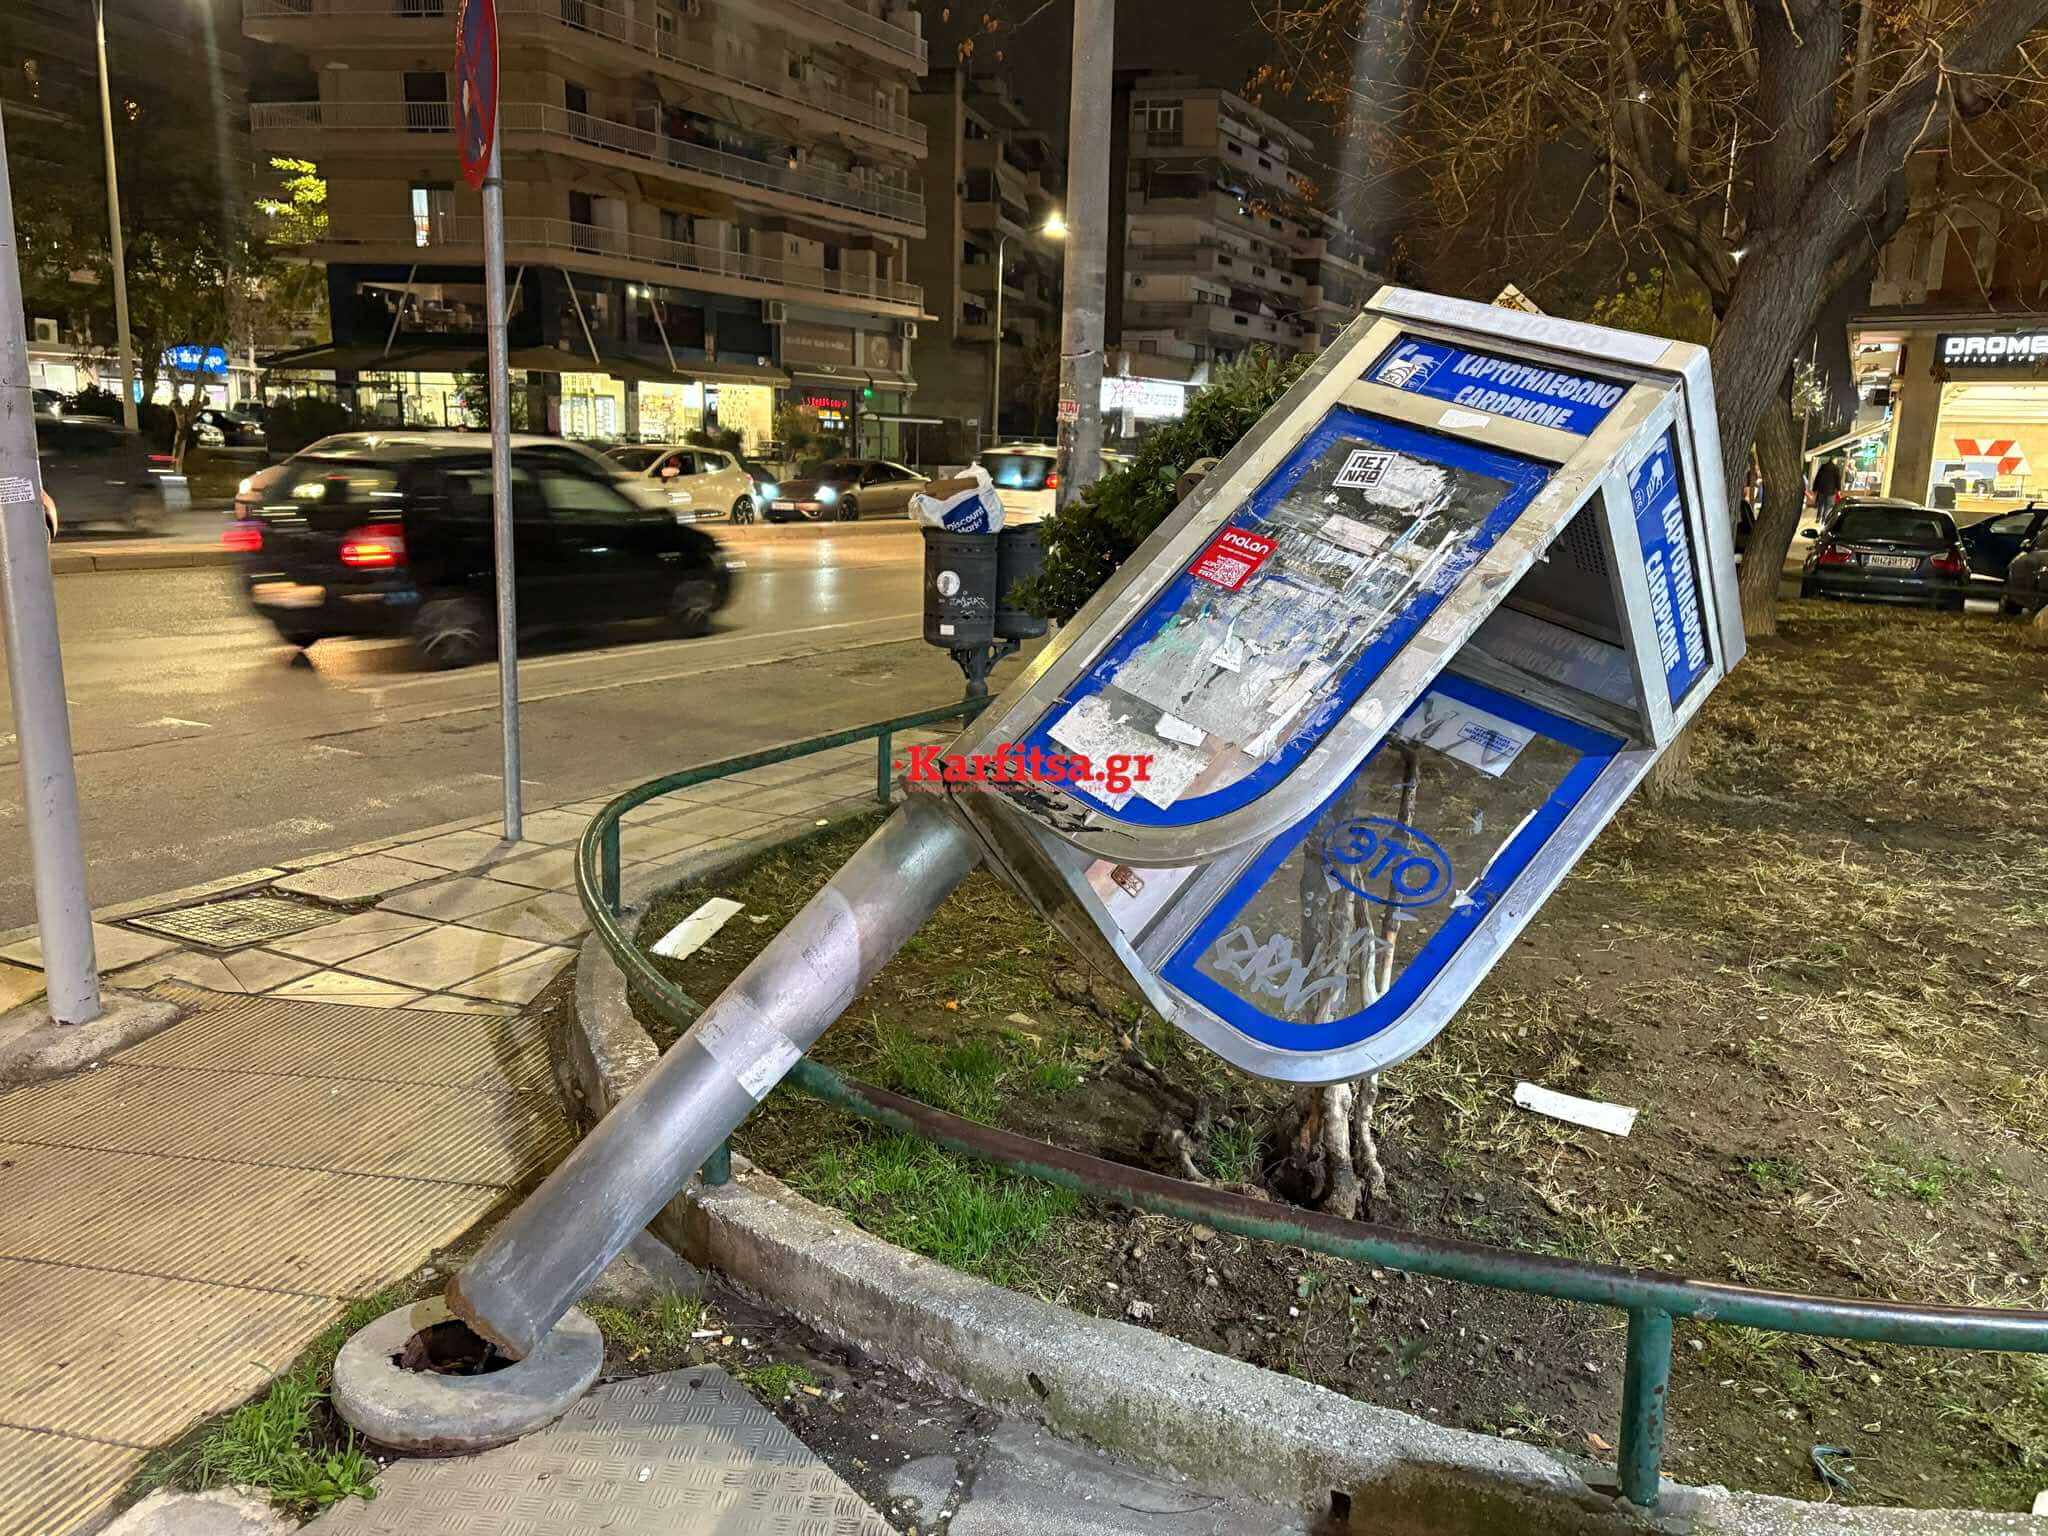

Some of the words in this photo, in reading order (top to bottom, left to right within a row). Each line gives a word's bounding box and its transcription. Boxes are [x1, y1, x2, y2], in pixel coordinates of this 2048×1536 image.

[1452, 353, 1625, 409] ΚΑΡΤΟΤΗΛΕΦΩΝΟ
[1453, 385, 1575, 428] CARDPHONE
[1646, 550, 1681, 674] CARDPHONE
[1662, 493, 1705, 672] ΚΑΡΤΟΤΗΛΕΦΩΝΟ
